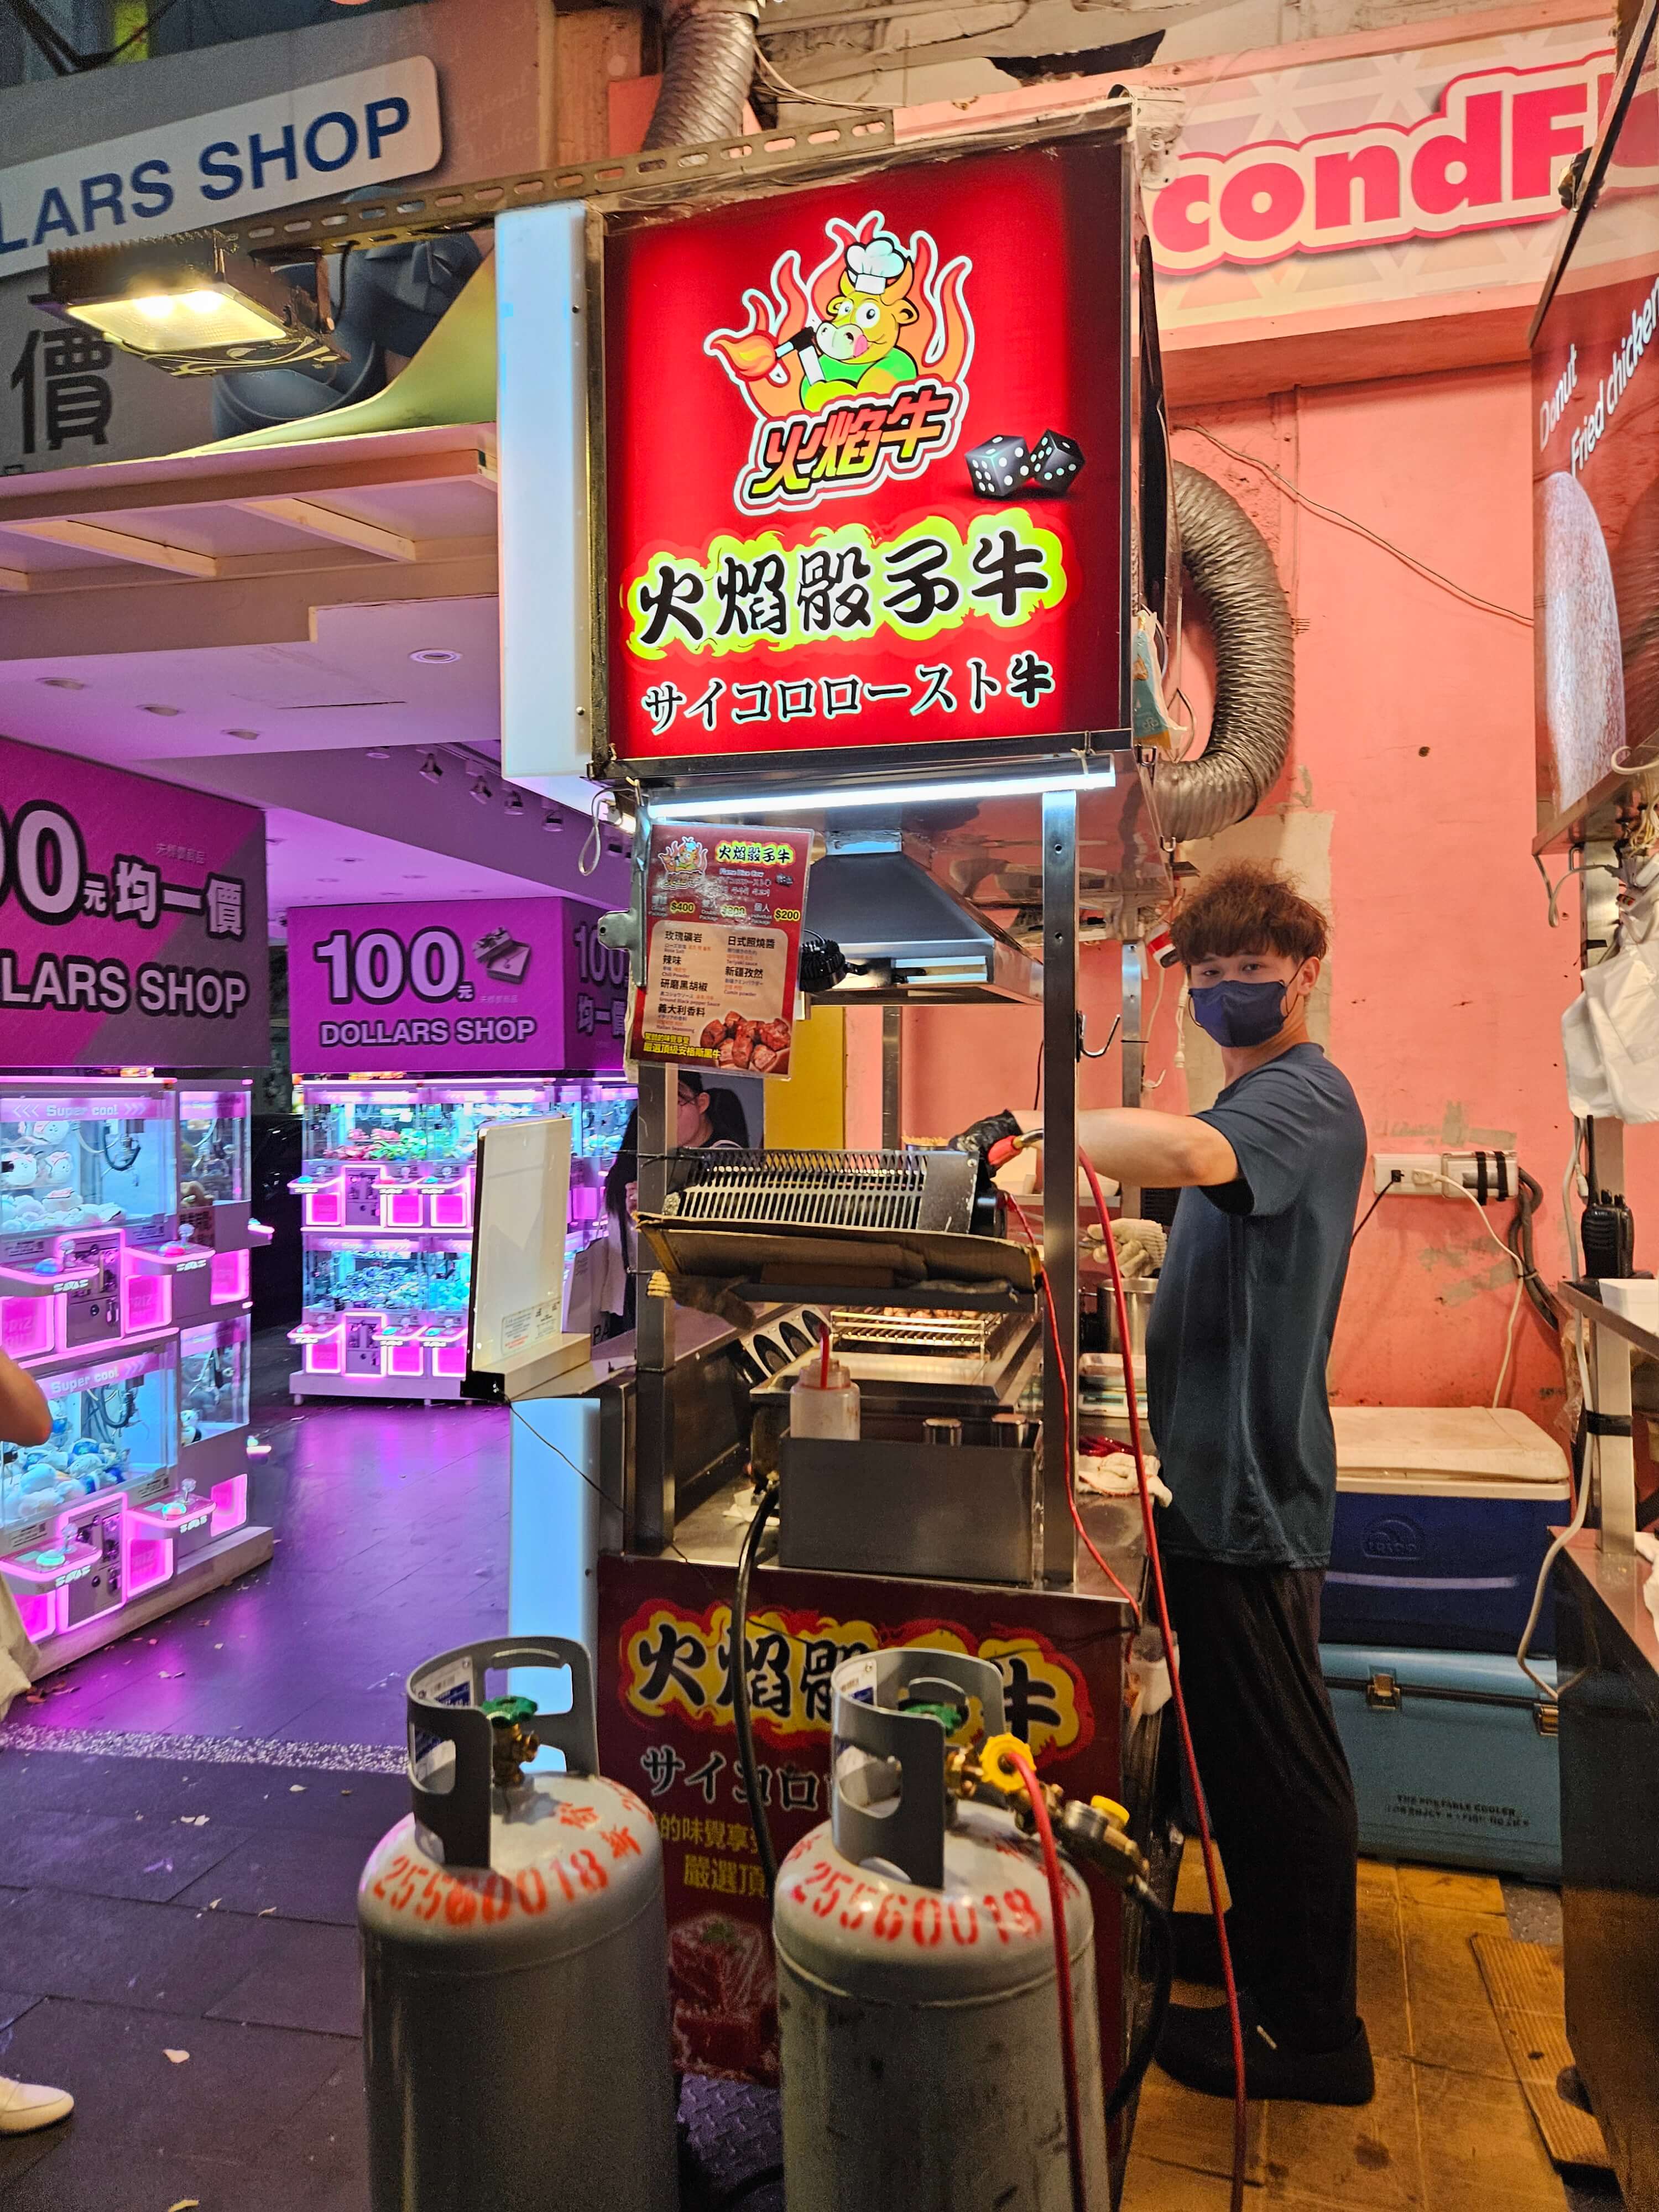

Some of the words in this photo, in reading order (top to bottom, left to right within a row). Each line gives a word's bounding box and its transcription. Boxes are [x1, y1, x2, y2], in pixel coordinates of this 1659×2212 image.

[199, 97, 410, 201] SHOP
[11, 330, 113, 454] 價
[1540, 343, 1577, 452] Donut
[751, 385, 953, 497] 火焰牛
[1571, 379, 1605, 478] Fried
[638, 529, 1048, 644] 火焰骰子牛
[644, 653, 1055, 732] サイコロロースト牛
[719, 845, 790, 863] 火焰骰子牛
[114, 857, 244, 938] 均一價
[671, 902, 694, 912] $400
[775, 910, 800, 920] $200
[574, 924, 629, 987] 100
[728, 936, 776, 950] 日式照燒醬
[662, 954, 682, 966] 辣味
[725, 966, 764, 979] 新疆孜然
[0, 953, 129, 1012] LARS
[138, 966, 249, 1016] SHOP
[660, 978, 708, 992] 研磨黑胡椒
[658, 1003, 706, 1017] 義大利香料
[319, 1020, 449, 1047] DOLLARS
[455, 1017, 536, 1044] SHOP
[46, 1105, 88, 1118] Super
[92, 1104, 119, 1115] cool
[50, 1375, 91, 1394] Super
[93, 1366, 120, 1383] cool
